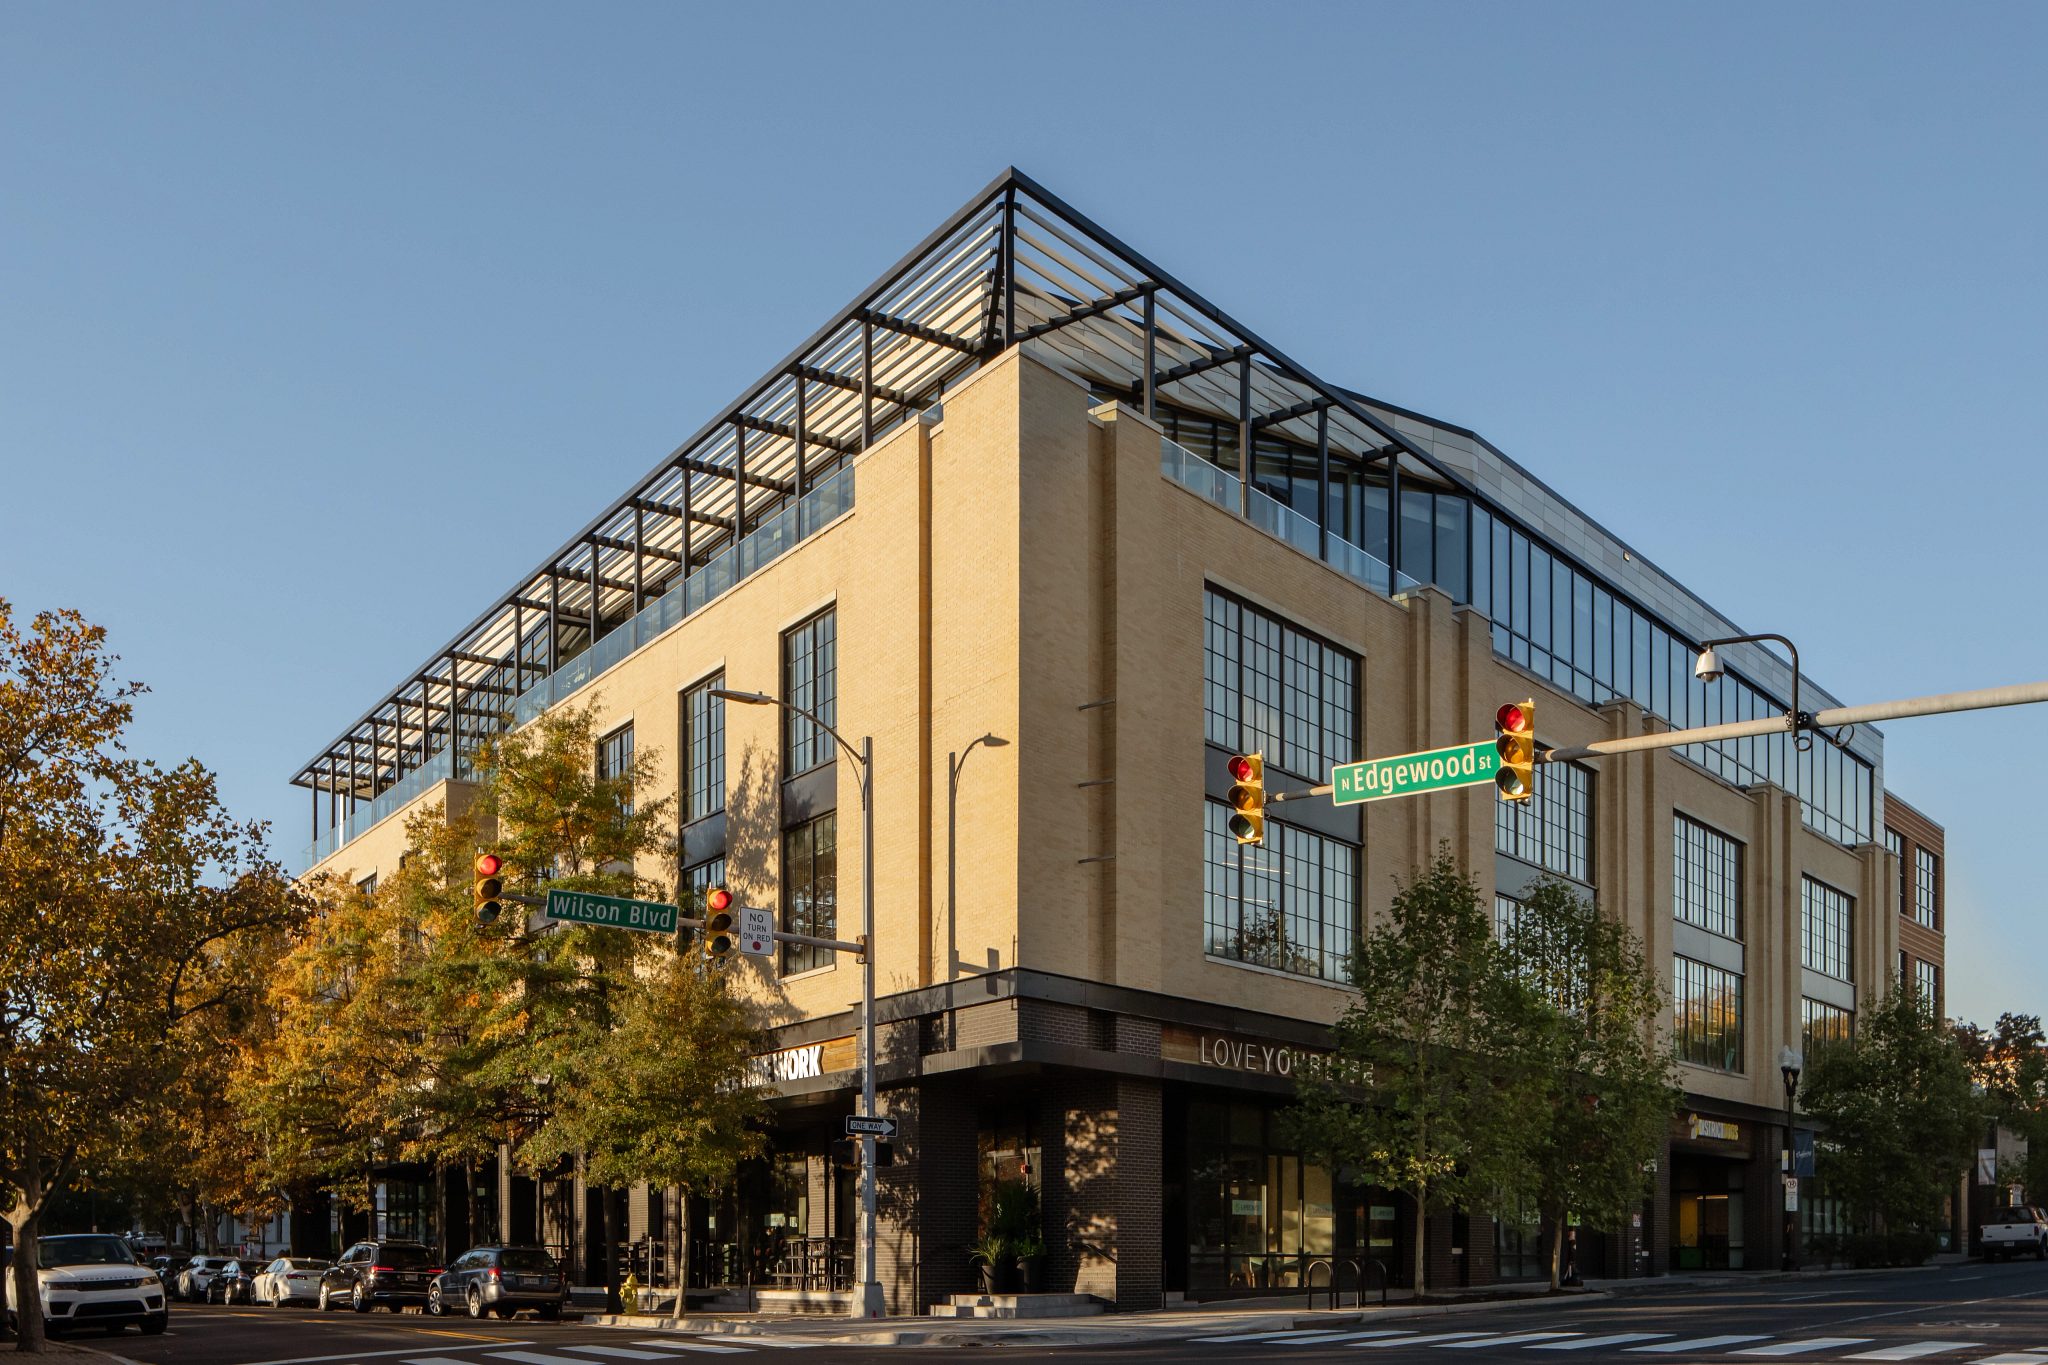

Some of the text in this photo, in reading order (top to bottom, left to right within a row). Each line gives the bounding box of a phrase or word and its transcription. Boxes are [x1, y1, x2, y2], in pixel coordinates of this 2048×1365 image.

[1341, 777, 1350, 791] N
[1353, 748, 1475, 794] Edgewood
[553, 895, 671, 928] Wilson Blvd
[749, 912, 764, 923] NO
[743, 932, 771, 942] ON RED
[748, 923, 767, 933] TURN
[773, 1045, 822, 1083] WORK
[1200, 1036, 1257, 1070] LOVE
[851, 1121, 883, 1131] ONE WAY
